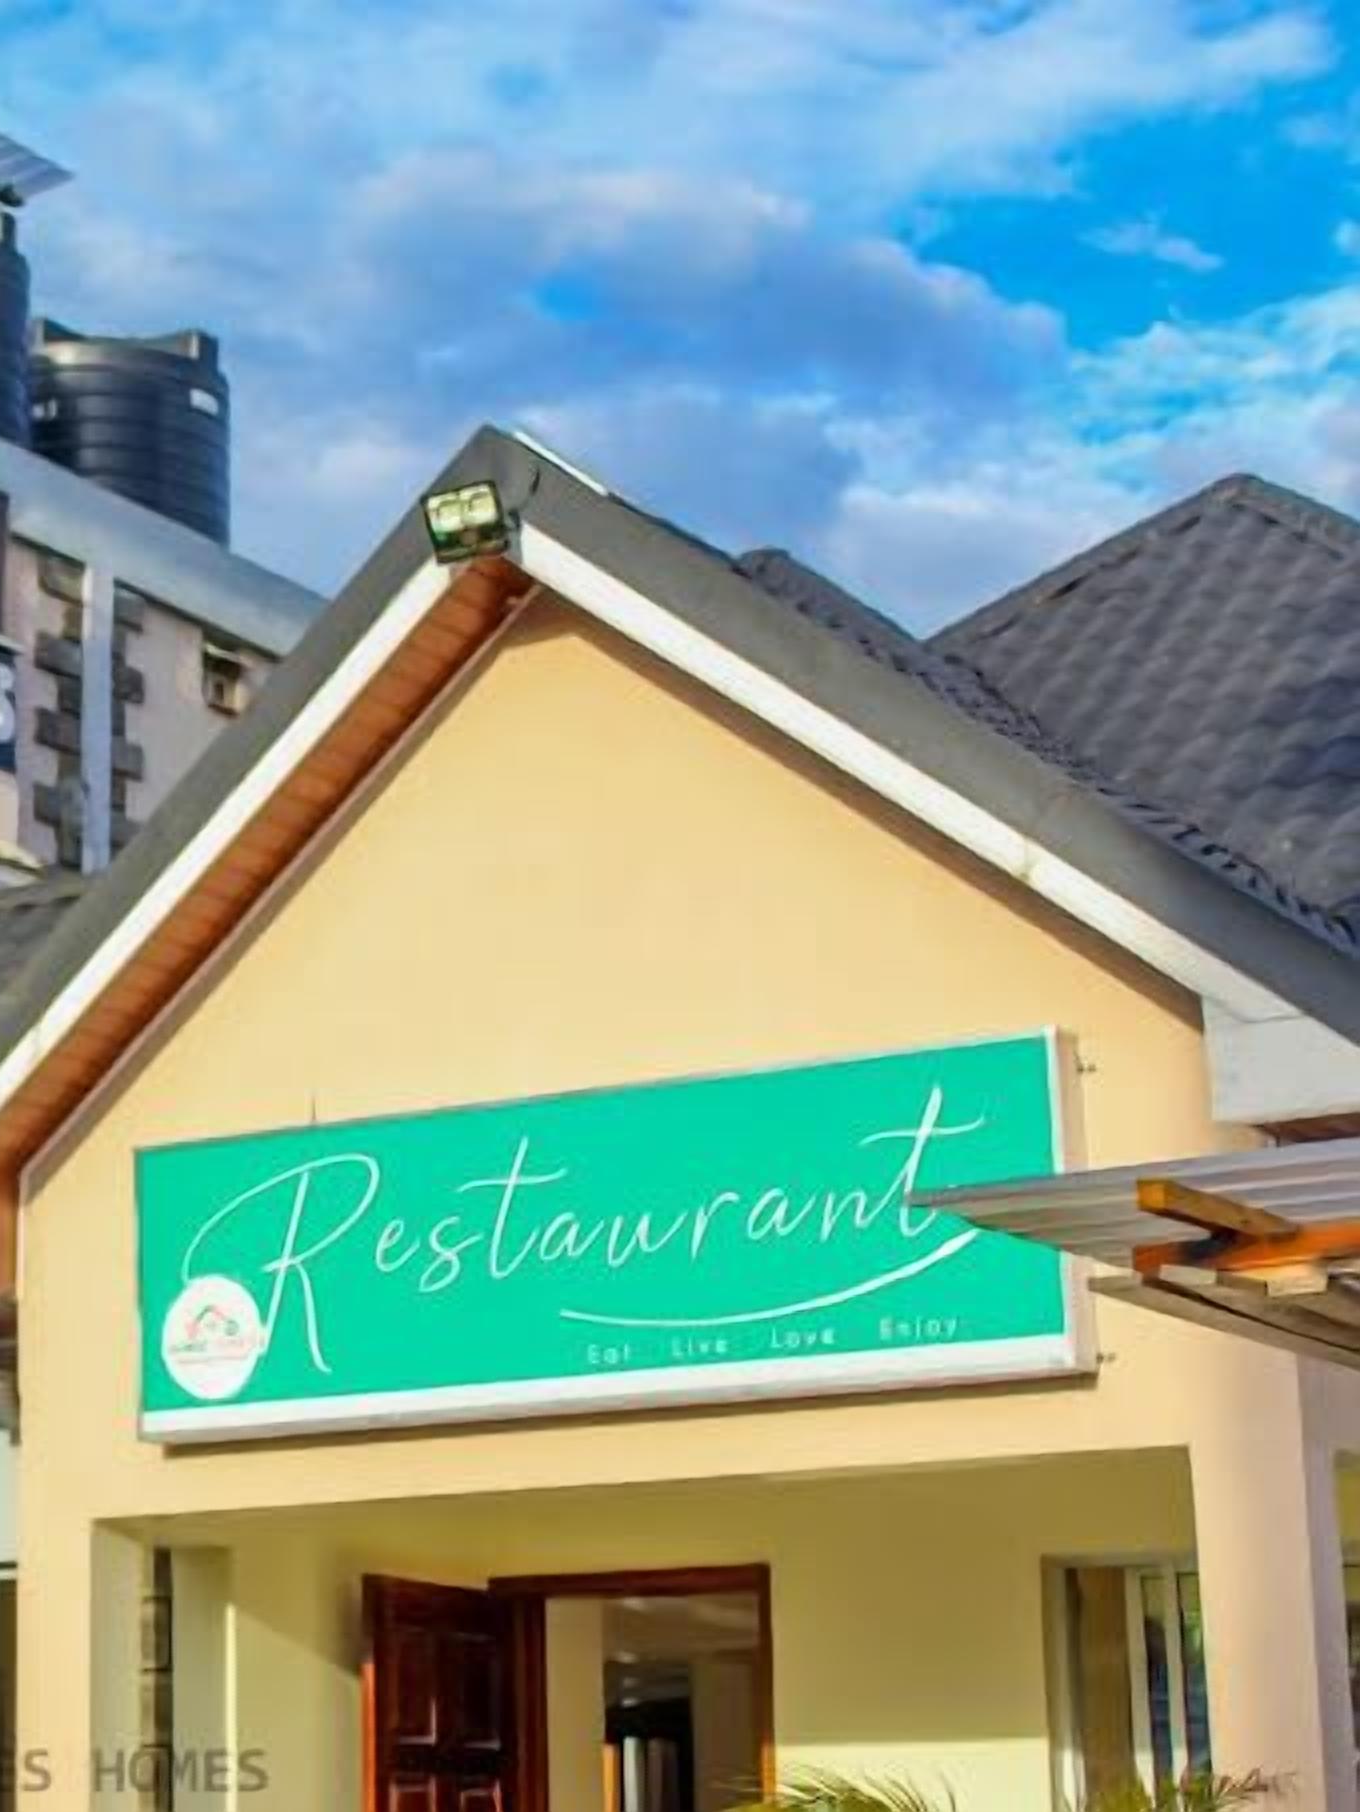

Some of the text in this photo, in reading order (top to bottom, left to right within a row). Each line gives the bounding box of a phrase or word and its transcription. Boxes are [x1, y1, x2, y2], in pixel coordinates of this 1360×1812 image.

[181, 1084, 985, 1374] Restaurant
[586, 1316, 958, 1365] Eat Live Love Enjoy
